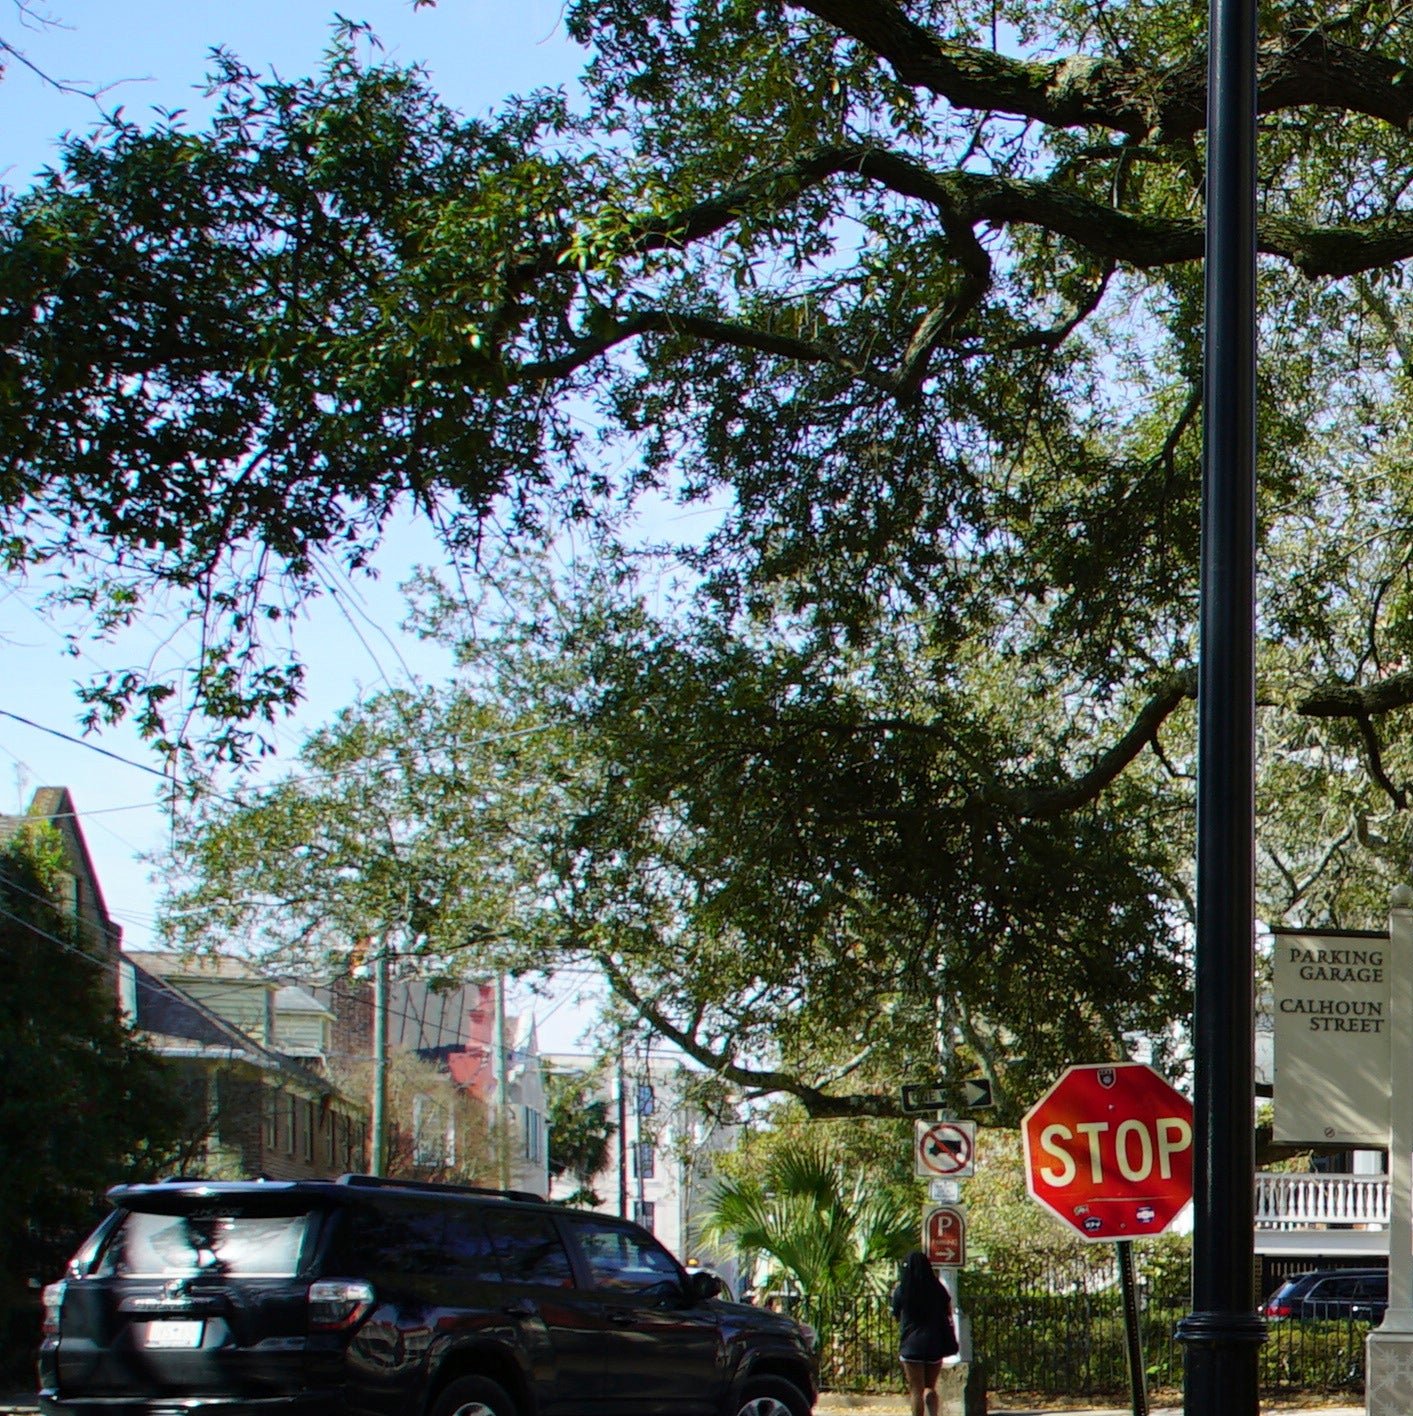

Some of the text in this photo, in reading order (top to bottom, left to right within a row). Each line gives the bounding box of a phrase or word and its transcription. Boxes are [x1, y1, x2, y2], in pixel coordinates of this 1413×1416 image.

[1290, 949, 1383, 965] PARKING
[1300, 966, 1384, 983] GARAGE
[1280, 999, 1382, 1016] CALHOUN
[1310, 1017, 1385, 1033] STREET
[1040, 1117, 1192, 1187] STOP
[938, 1216, 952, 1236] P
